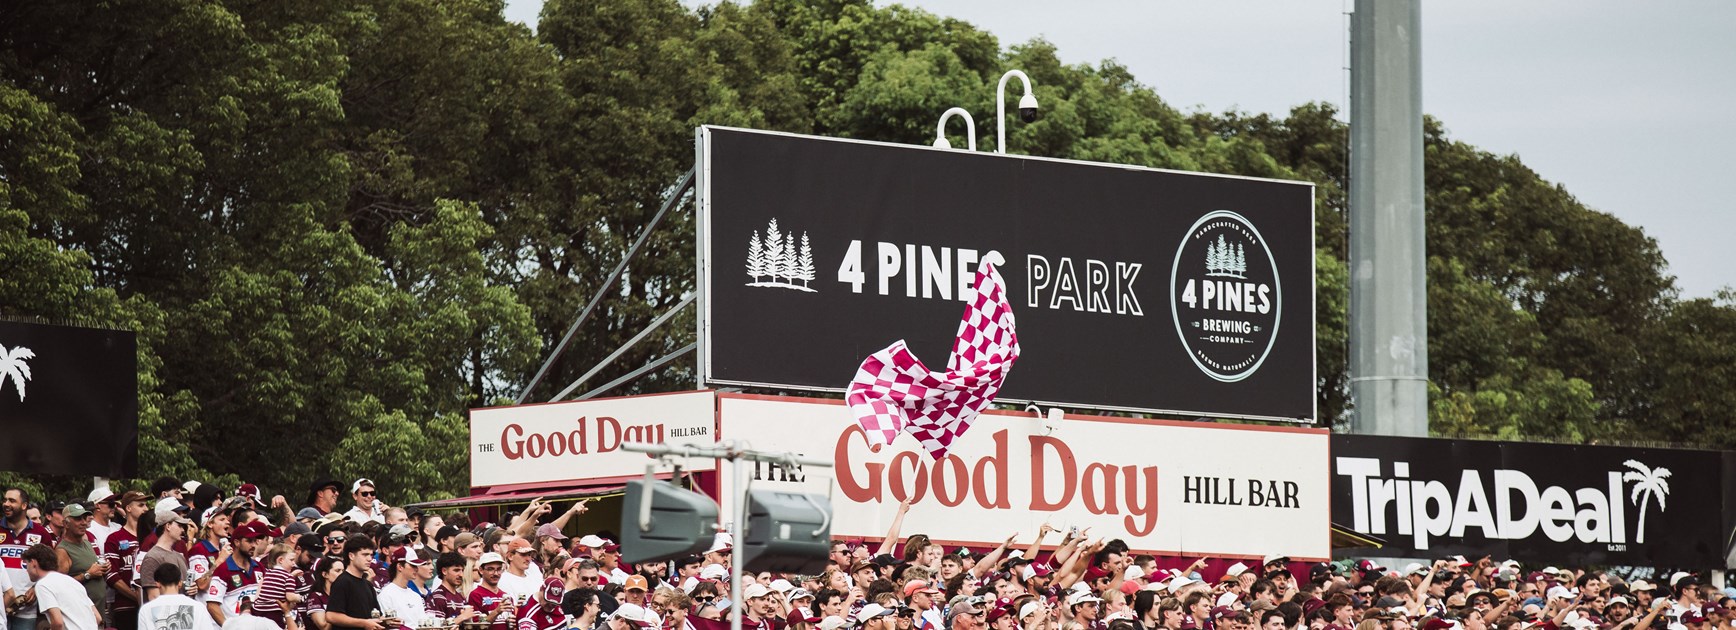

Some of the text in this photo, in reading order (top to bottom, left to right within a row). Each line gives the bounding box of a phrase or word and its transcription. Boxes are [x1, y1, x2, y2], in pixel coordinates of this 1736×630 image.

[1195, 221, 1257, 245] HANDCRAFTED BEER
[837, 239, 1144, 316] 4 PINES PARK
[1181, 278, 1271, 315] 4 PINES
[1203, 318, 1251, 334] BREWING
[1209, 335, 1244, 344] COMPANY
[1197, 349, 1256, 371] BREWED NATURALLY
[478, 416, 708, 460] THE Good Day HILL BAR
[835, 423, 1011, 510] Good
[1028, 435, 1158, 537] Day
[1183, 475, 1243, 506] HILL
[1247, 479, 1300, 509] BAR
[1336, 456, 1626, 550] TripADeal
